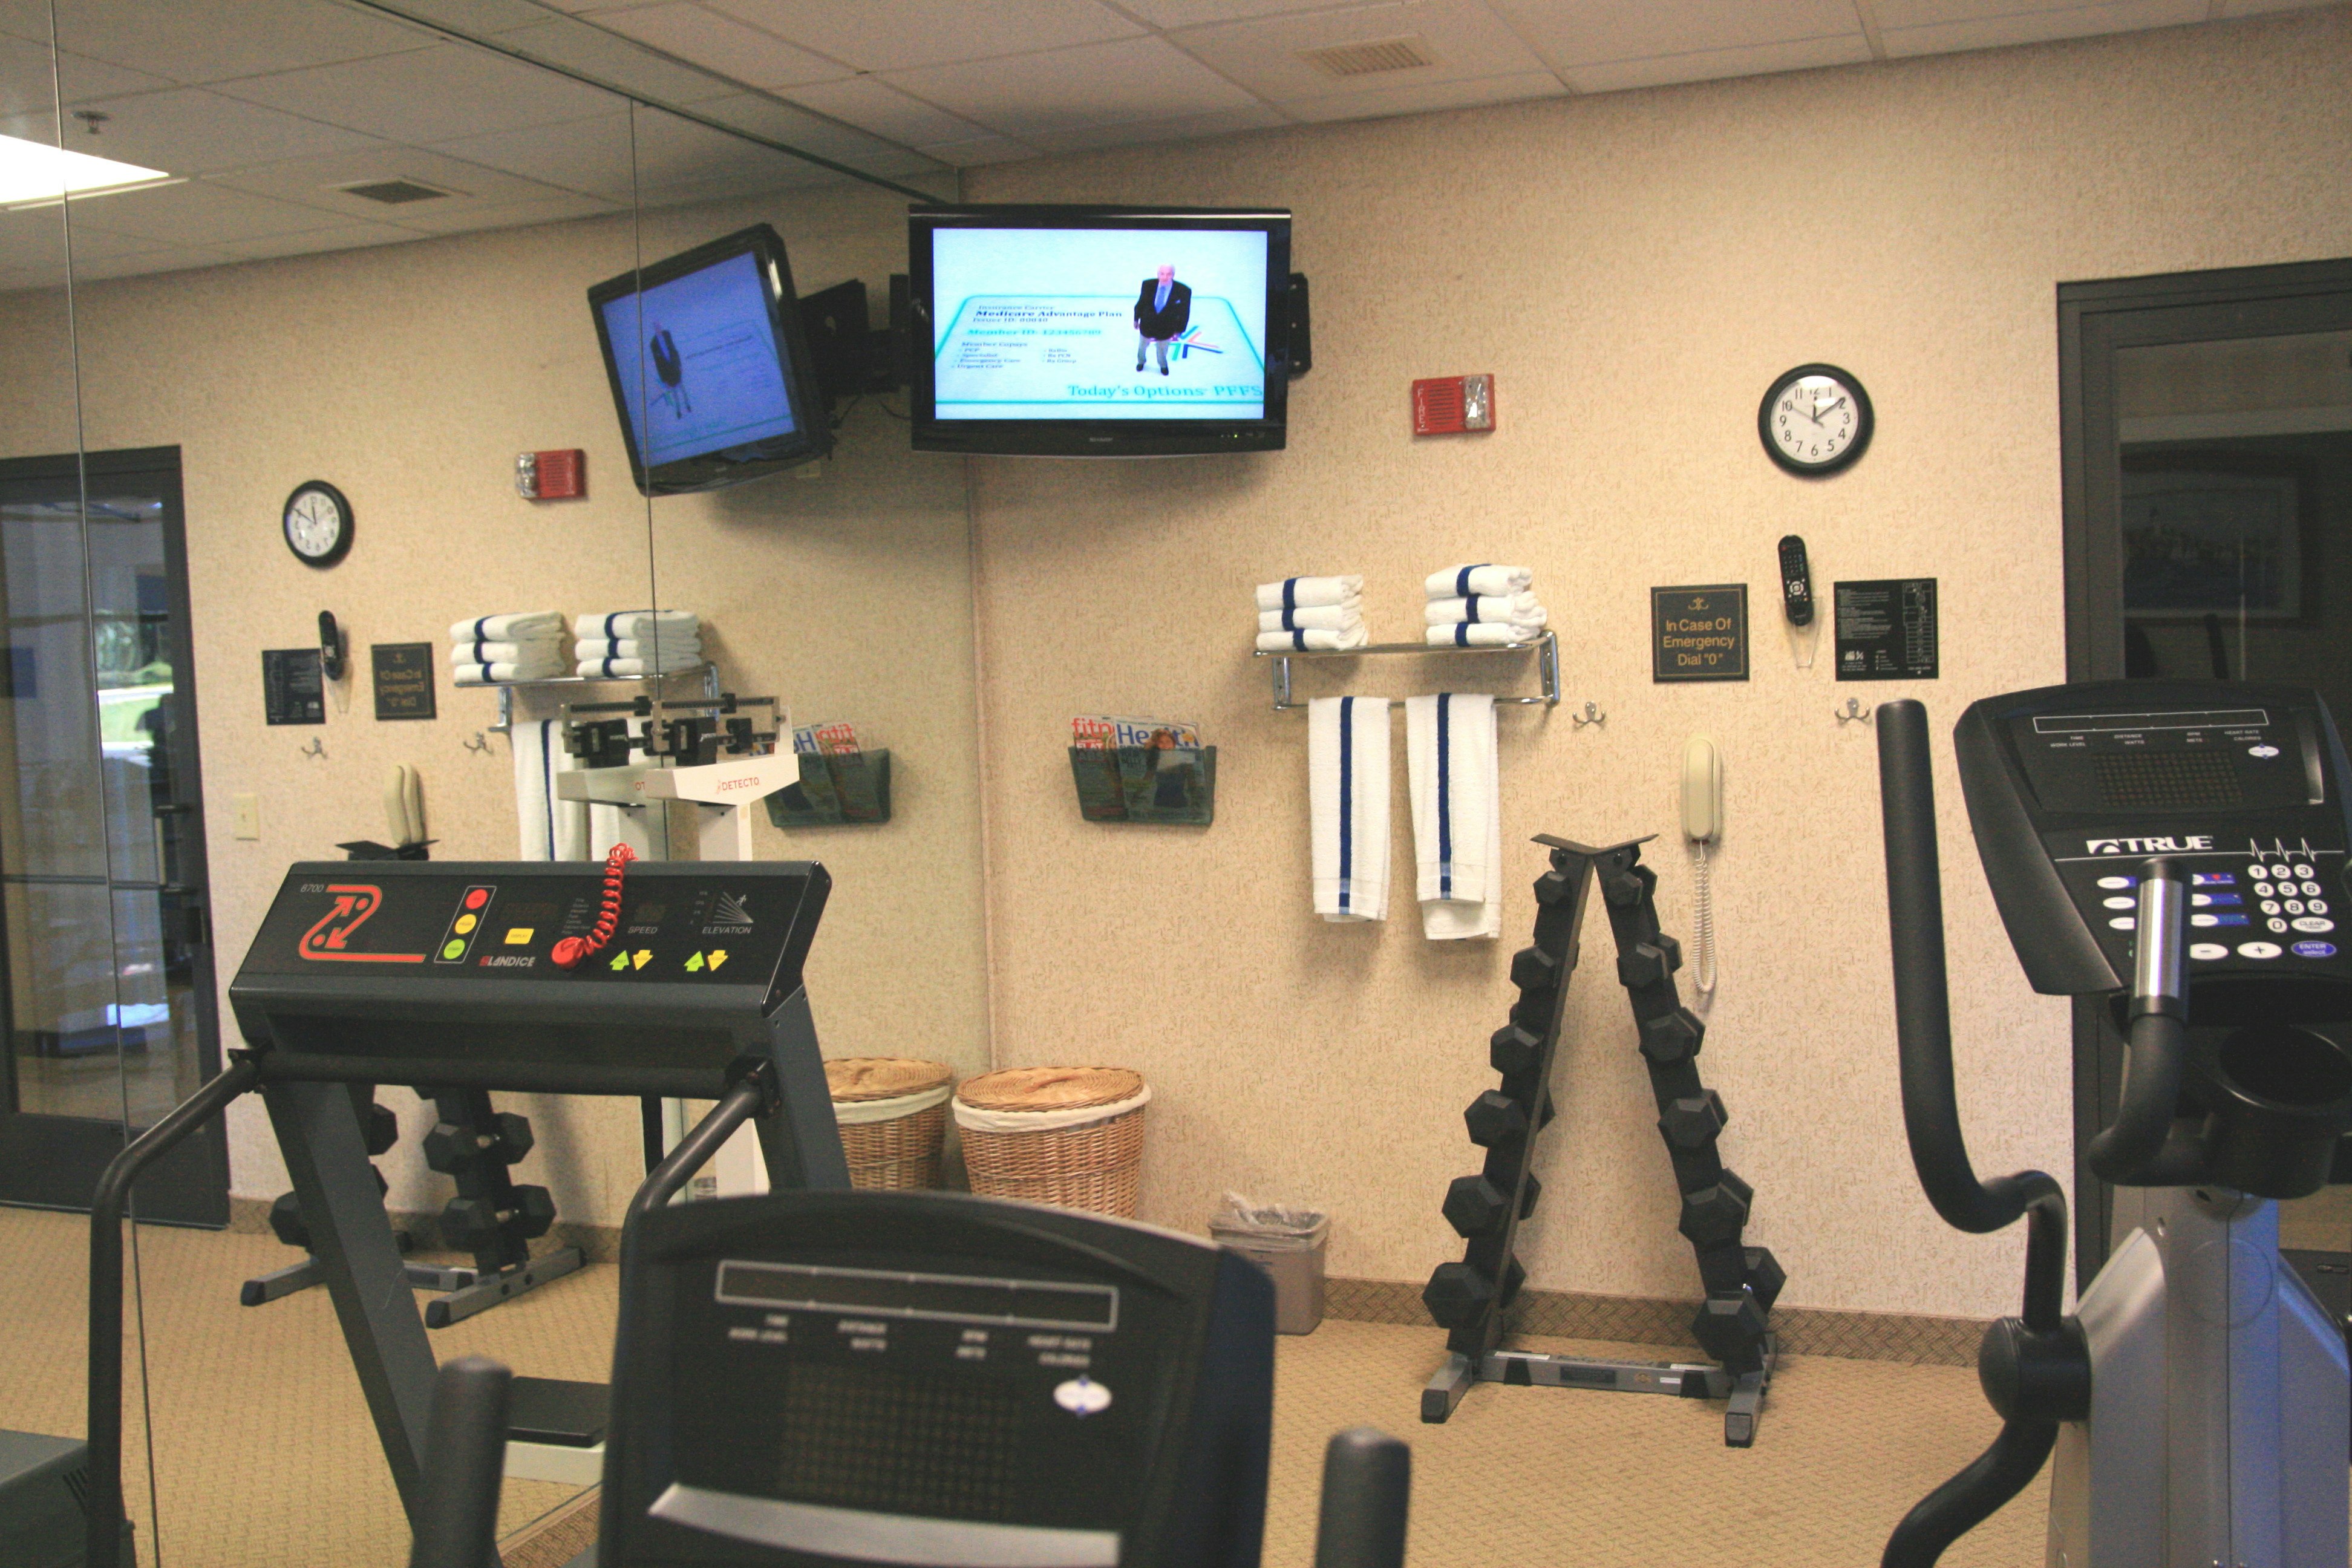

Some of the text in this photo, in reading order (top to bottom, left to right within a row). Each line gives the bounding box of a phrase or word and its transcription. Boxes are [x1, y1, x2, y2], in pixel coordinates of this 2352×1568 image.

[1068, 385, 1263, 399] Today's Options PFFS
[1795, 388, 1803, 399] 11
[1782, 400, 1793, 412] 10
[1779, 415, 1787, 427] 9
[1843, 413, 1850, 424] 3
[1784, 430, 1792, 442] 8
[1838, 428, 1846, 440] 4
[1795, 440, 1803, 452] 7
[1811, 445, 1818, 456] 6
[1827, 439, 1835, 452] 5
[1666, 617, 1732, 632] In Case Of
[1663, 635, 1735, 650] Emergency
[1677, 653, 1701, 666] Dial
[721, 777, 760, 791] DETECTO
[2118, 835, 2214, 852] TRUE
[2276, 867, 2286, 876] 2
[2299, 867, 2308, 875] 3
[2259, 884, 2315, 893] 4 5 6
[2265, 903, 2322, 912] 7 8 9
[702, 926, 753, 935] ELEVATION
[2272, 921, 2282, 929] 0
[486, 956, 536, 967] LANDICE
